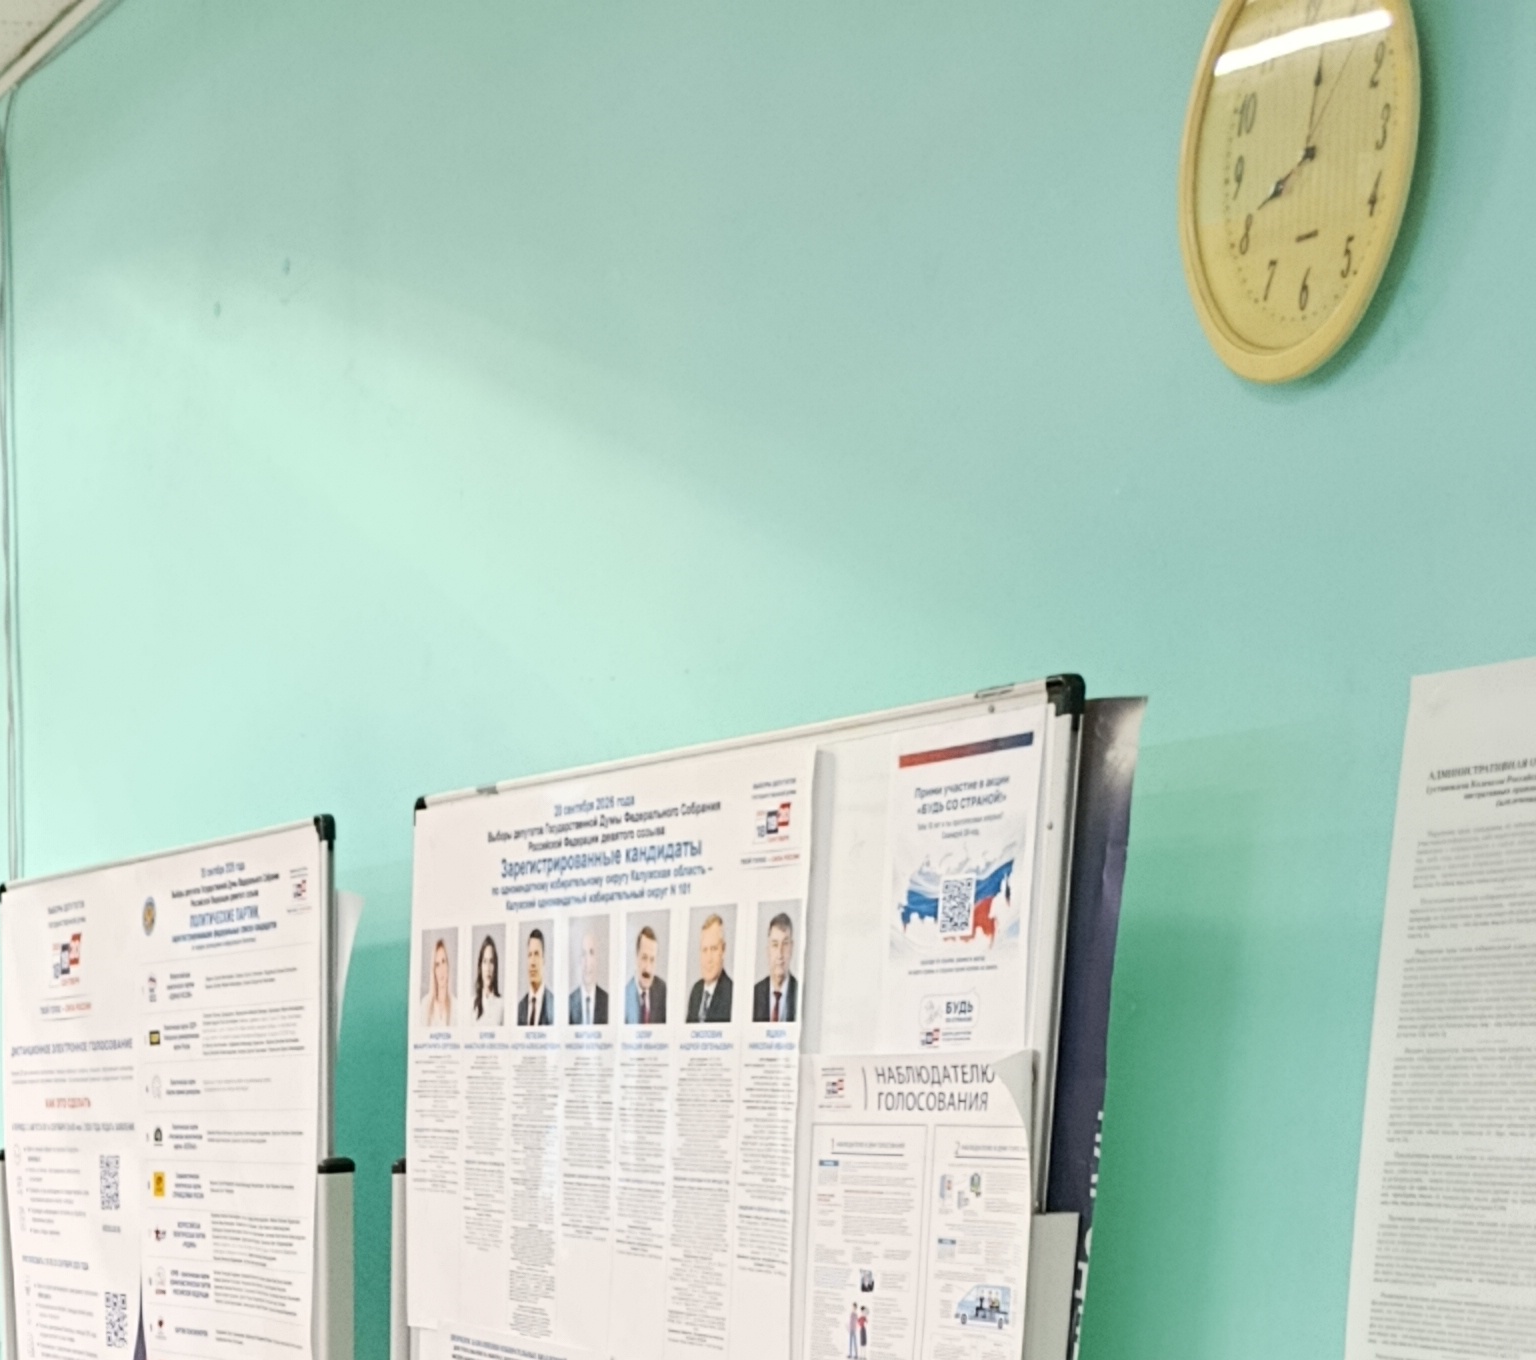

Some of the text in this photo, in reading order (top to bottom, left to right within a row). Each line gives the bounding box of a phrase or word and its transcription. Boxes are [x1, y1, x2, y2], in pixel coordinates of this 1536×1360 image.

[1370, 42, 1386, 88] 2
[1237, 92, 1257, 138] 10
[1375, 104, 1390, 151] 3
[1231, 156, 1245, 200] 9
[1367, 170, 1382, 218] 4
[1239, 214, 1253, 255] 8
[1340, 236, 1354, 279] 5
[1263, 259, 1278, 302] 7
[1300, 268, 1310, 311] 6
[915, 776, 1009, 799] Прими участие в акции
[917, 802, 944, 814] «БУДЬ
[946, 799, 958, 811] СО
[488, 831, 512, 843] Выборы
[600, 814, 622, 827] Думы
[624, 807, 679, 823] Федерального
[681, 801, 721, 815] Собрания
[501, 839, 702, 880] Зарегистрированные кандидаты
[946, 1001, 973, 1015] БУДЬ
[874, 1064, 995, 1087] НАБЛЮДАТЕЛЮ
[878, 1092, 988, 1111] ГОЛОСОВАНИЯ
